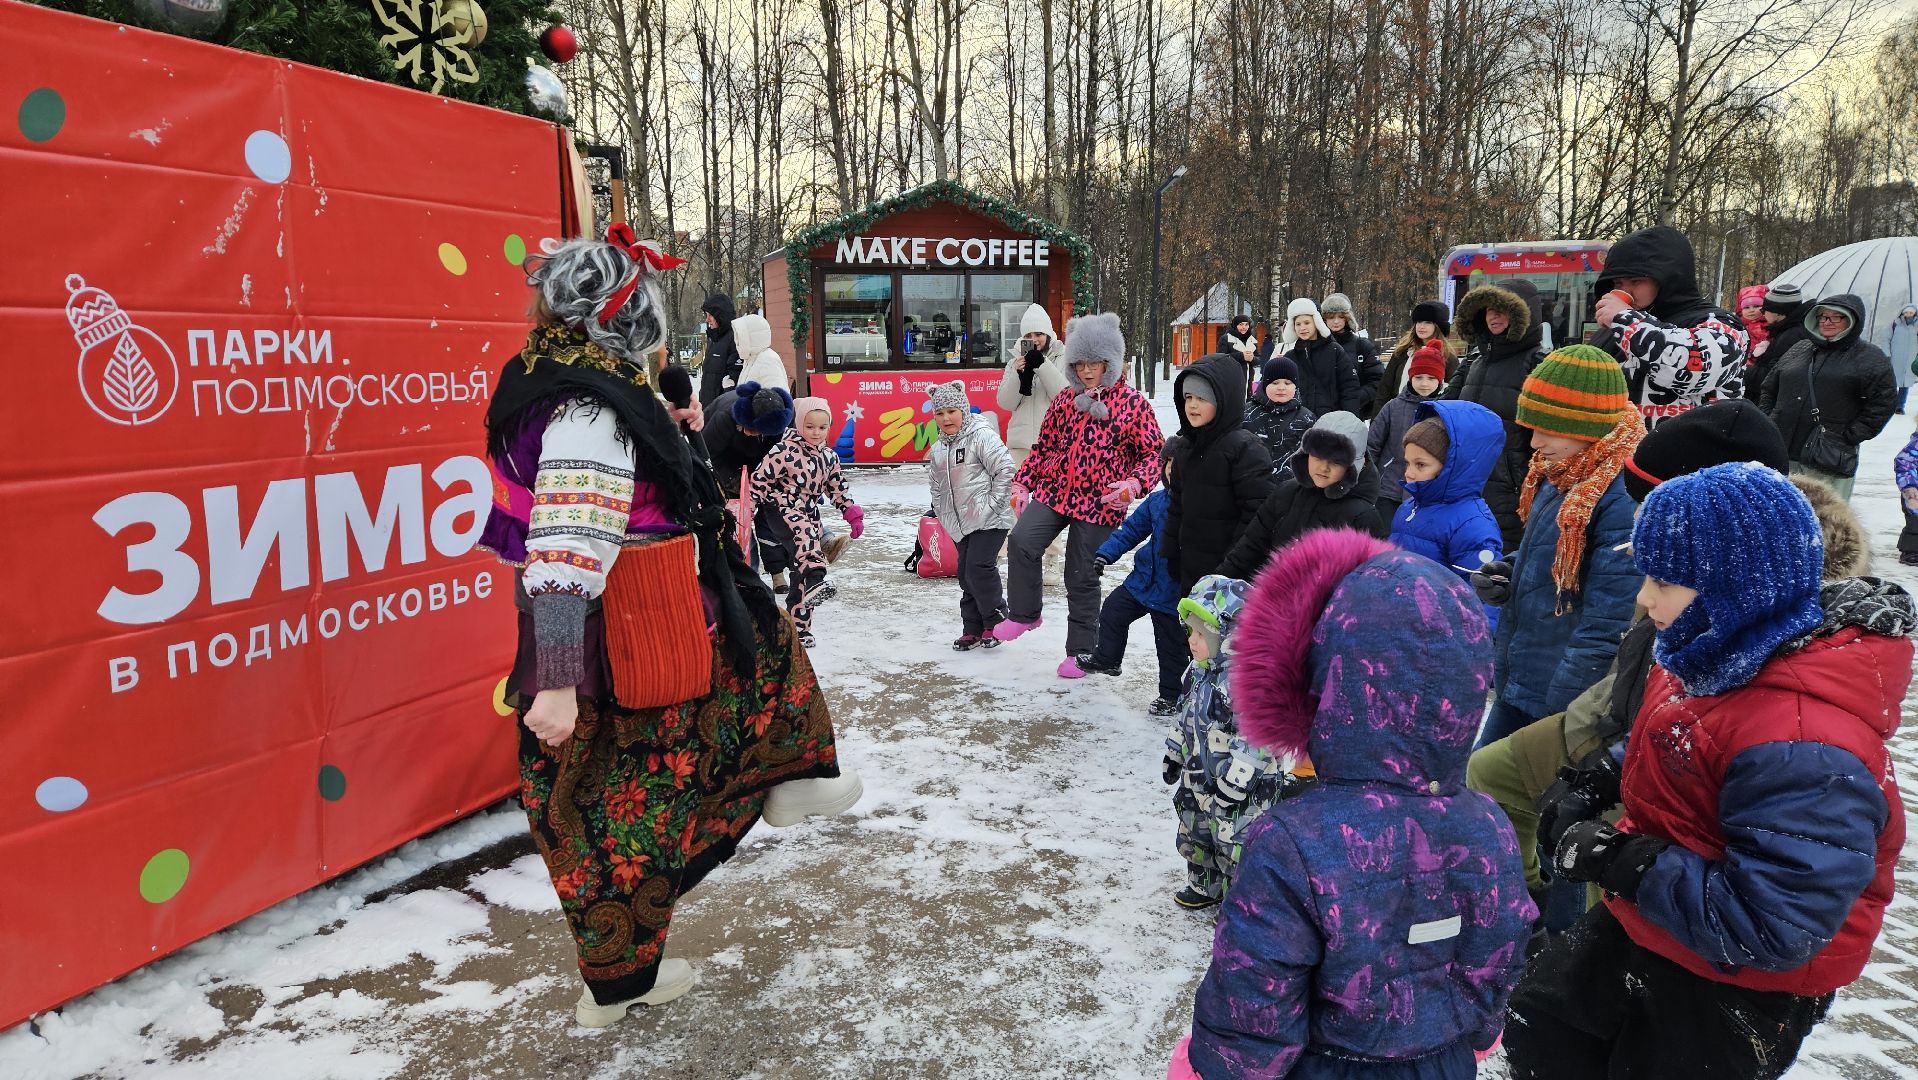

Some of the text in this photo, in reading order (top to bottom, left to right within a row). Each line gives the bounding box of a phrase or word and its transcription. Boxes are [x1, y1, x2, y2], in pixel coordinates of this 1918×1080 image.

[835, 236, 1049, 266] MAKE COFFEE
[186, 329, 334, 367] ПАРКИ
[192, 370, 489, 417] ПОДМОСКОВЬЯ
[167, 571, 494, 679] подмосковье
